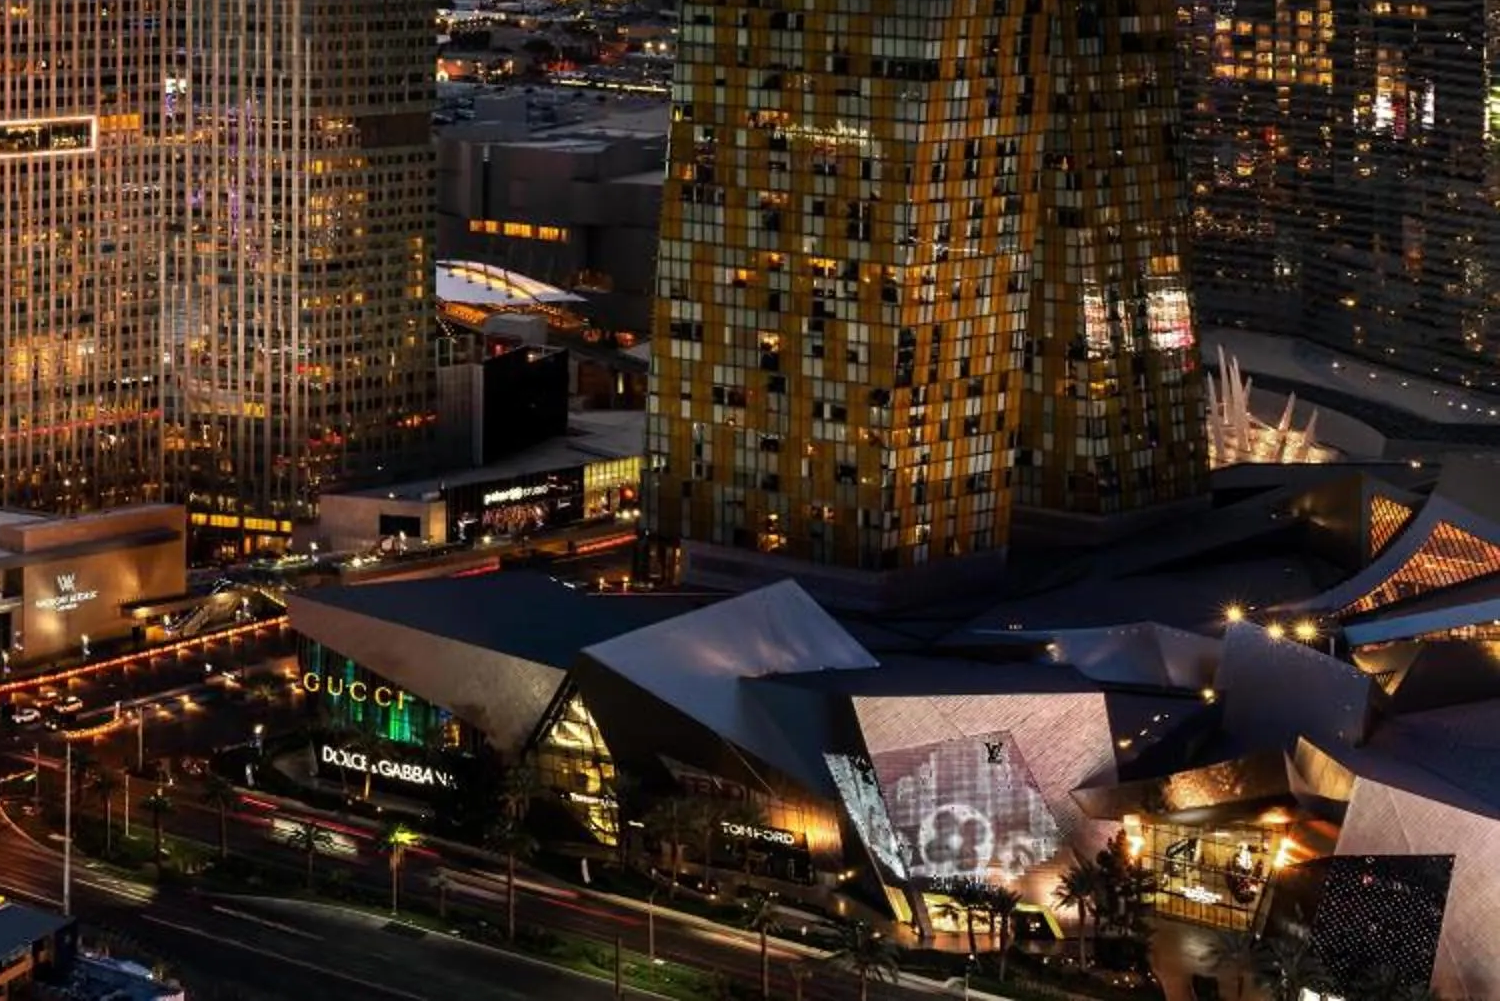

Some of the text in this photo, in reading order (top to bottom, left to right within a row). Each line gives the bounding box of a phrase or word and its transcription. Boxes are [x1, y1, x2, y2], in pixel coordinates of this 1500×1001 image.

[303, 672, 405, 710] GUCCI
[322, 745, 368, 772] DOLCE
[753, 827, 795, 845] FORD
